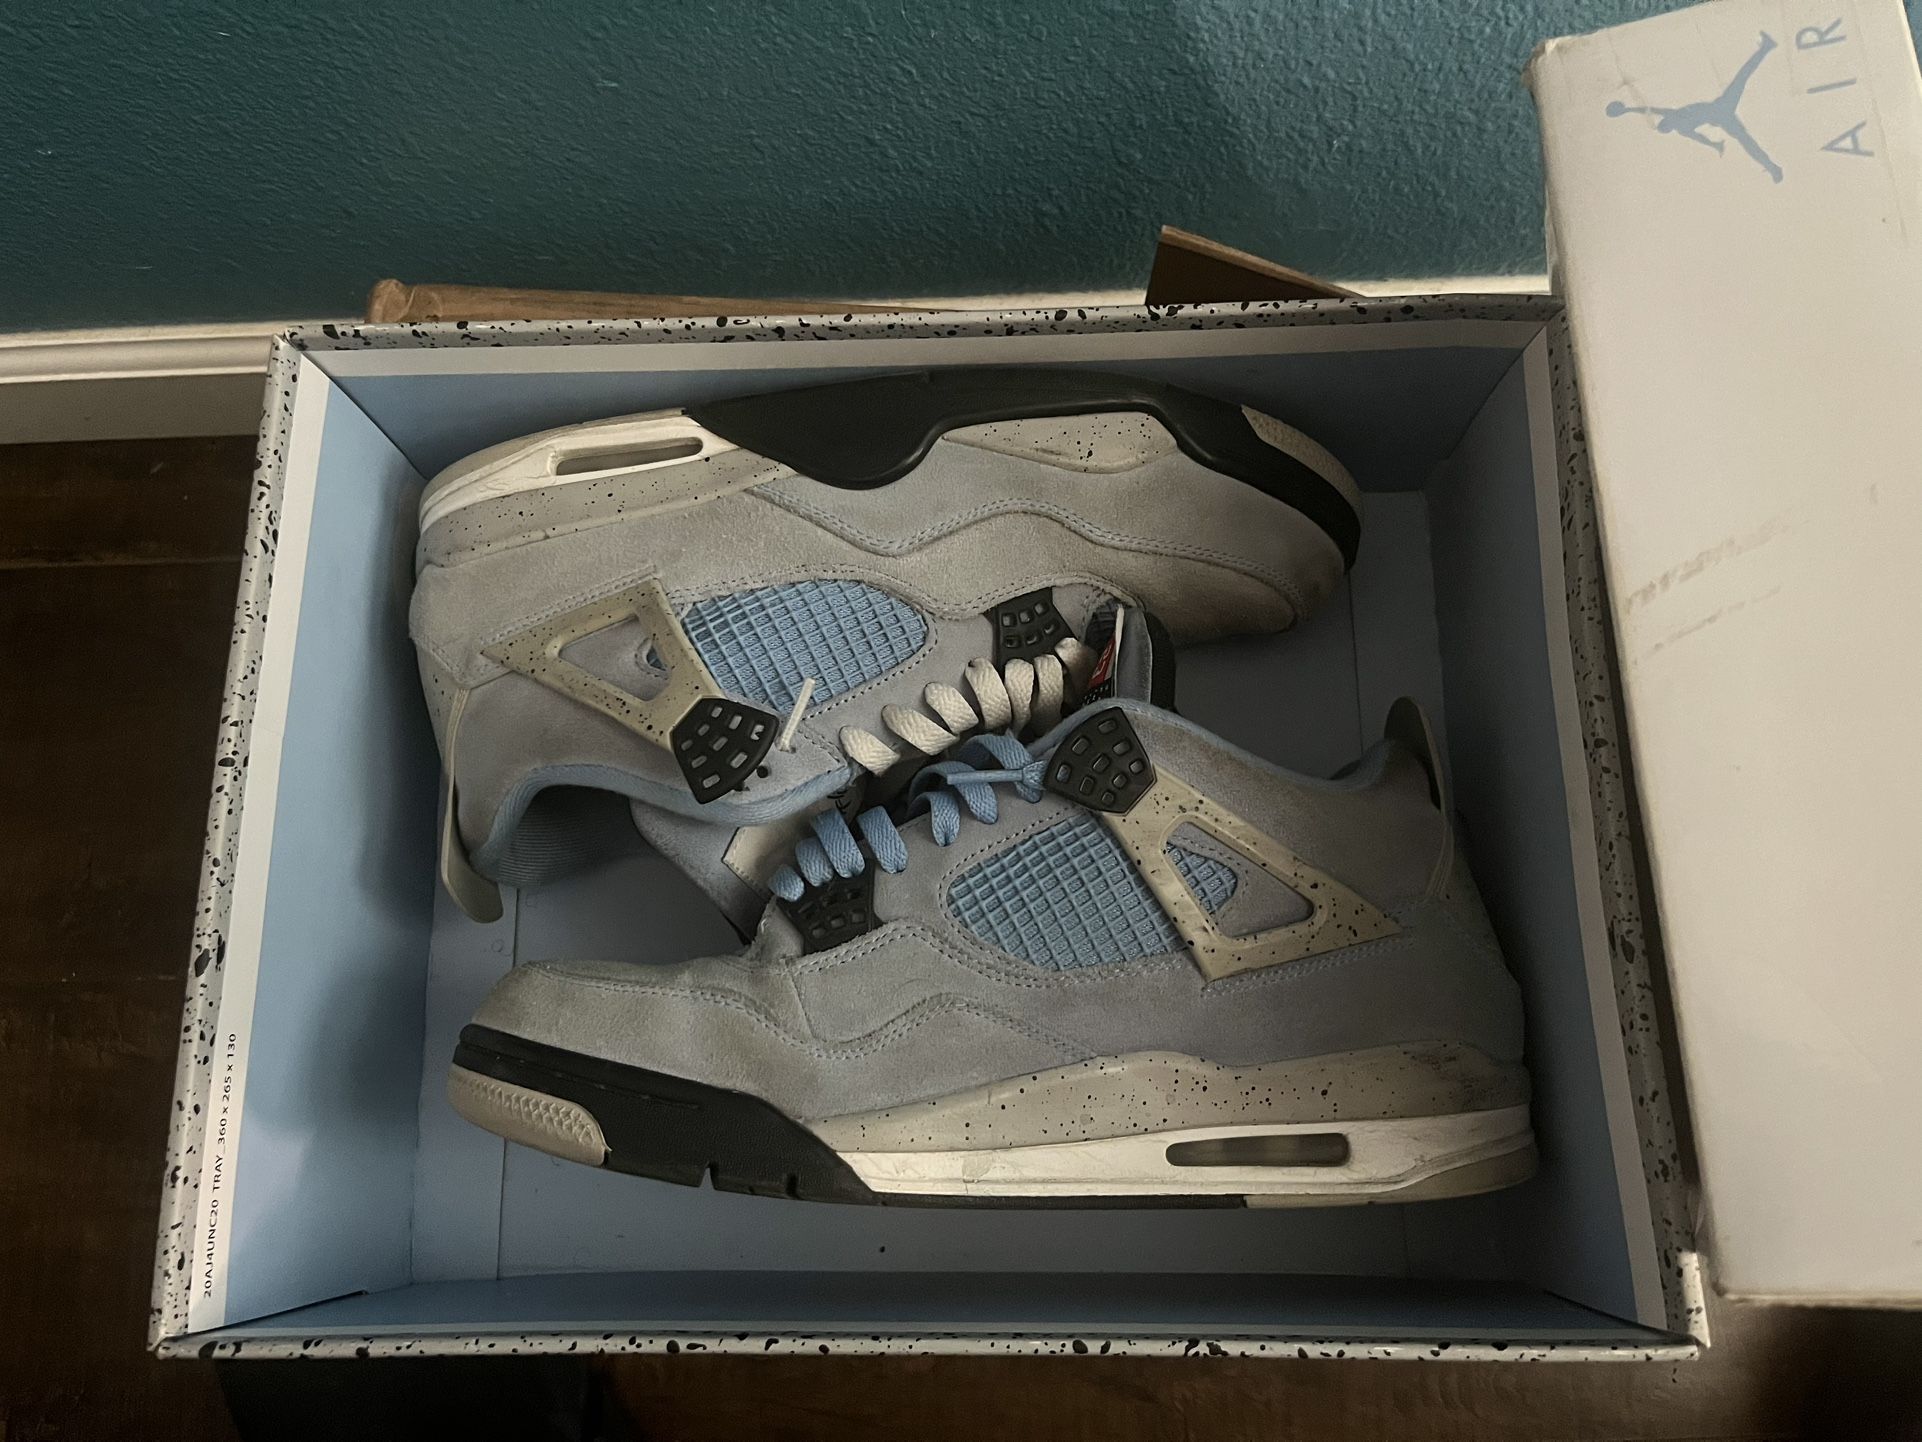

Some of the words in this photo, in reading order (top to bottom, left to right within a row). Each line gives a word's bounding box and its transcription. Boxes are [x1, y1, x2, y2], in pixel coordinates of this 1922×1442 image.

[1795, 17, 1875, 157] AIR
[203, 1199, 218, 1299] 20AJ4UNC20
[222, 1075, 232, 1103] 265
[227, 1033, 237, 1059] 130
